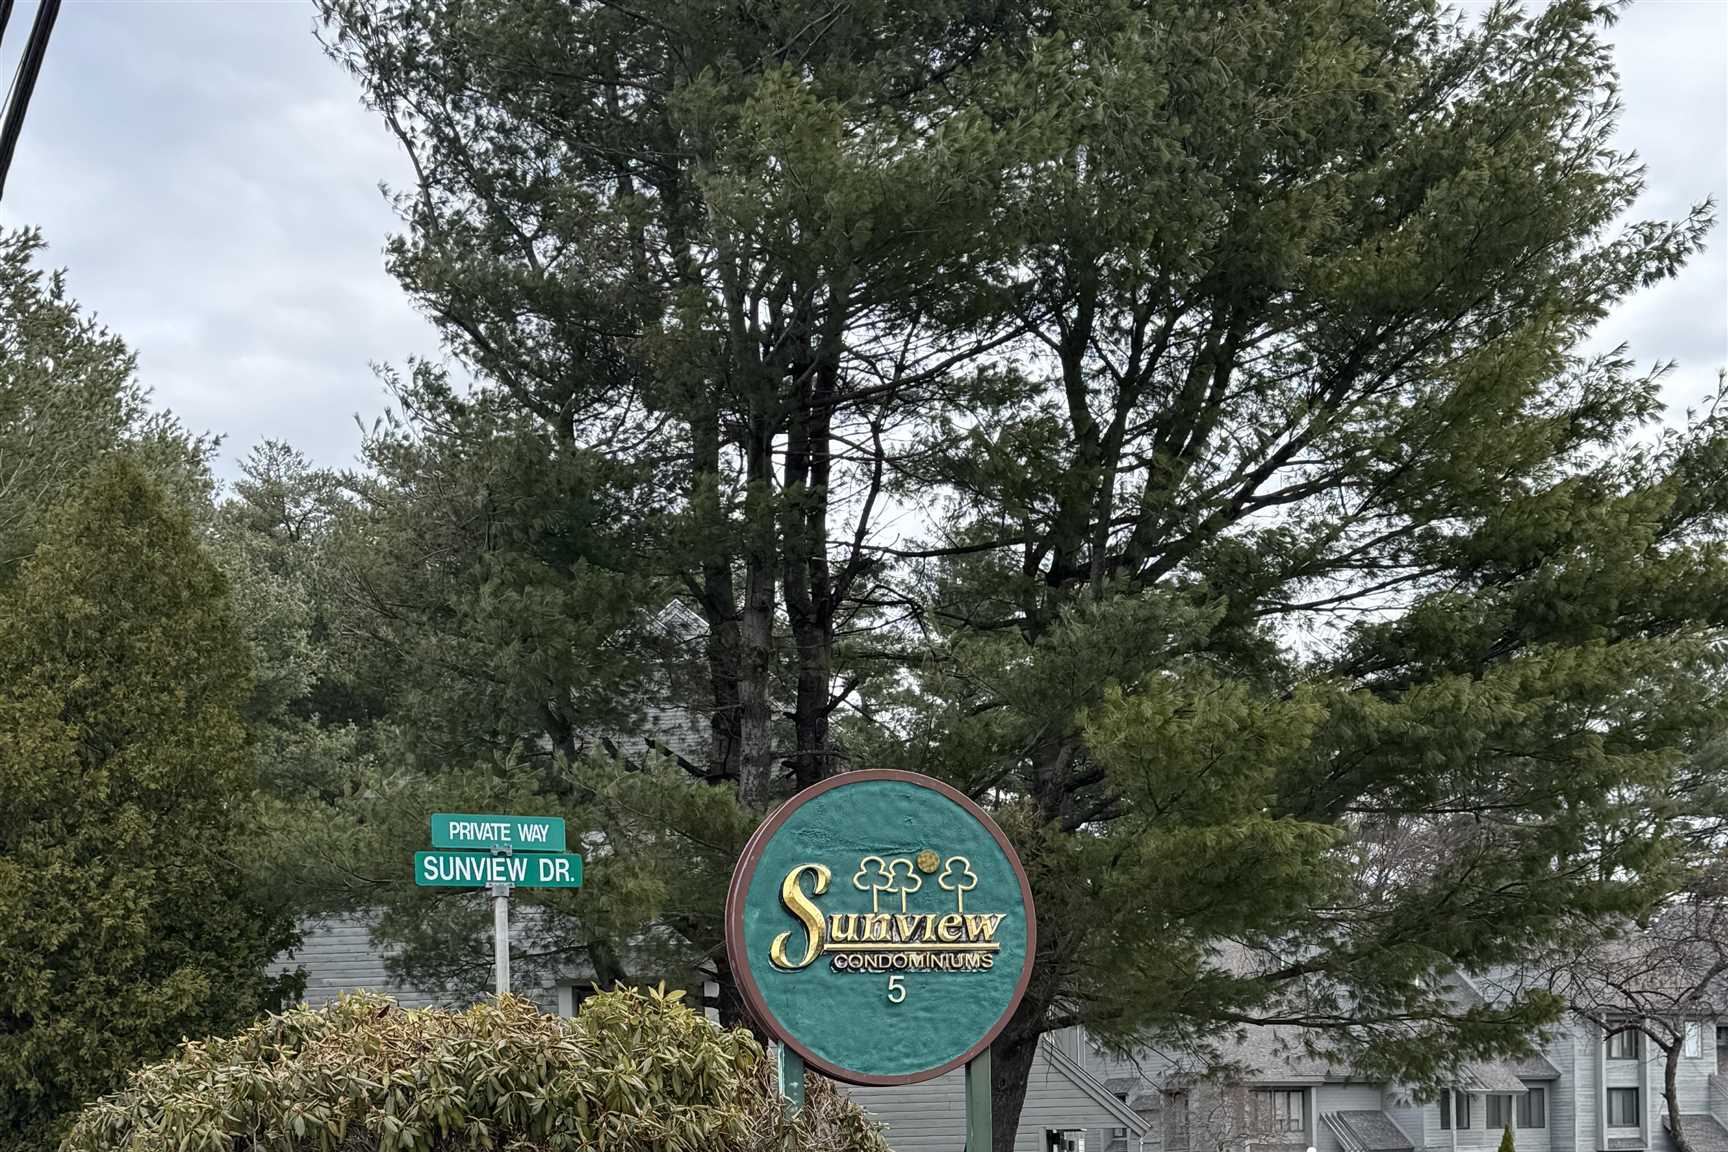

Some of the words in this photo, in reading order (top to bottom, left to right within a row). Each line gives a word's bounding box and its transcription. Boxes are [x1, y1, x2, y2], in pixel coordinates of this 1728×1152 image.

[449, 821, 511, 841] PRIVATE
[518, 823, 549, 843] WAY
[423, 856, 528, 881] SUNVIEW
[539, 858, 575, 882] DR.
[769, 863, 1007, 969] Sunview
[833, 953, 994, 969] CONDOMINIUMS
[887, 975, 906, 1003] 5
